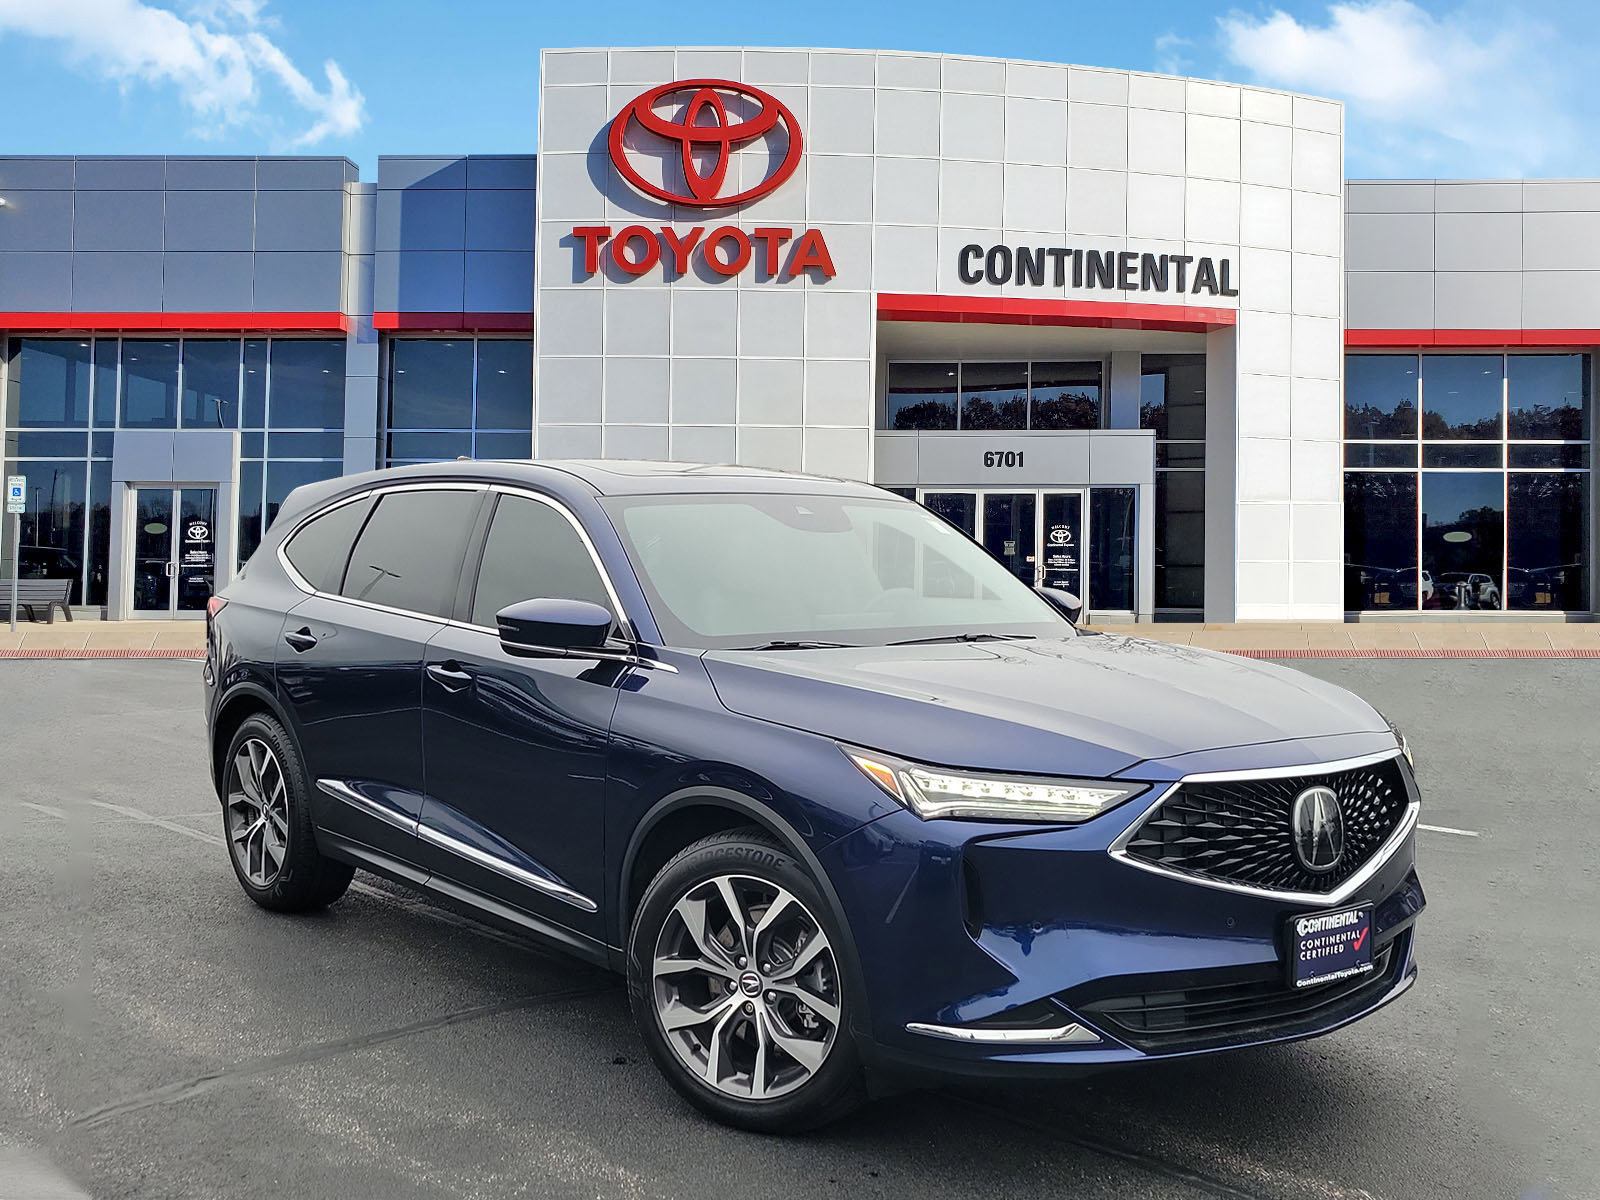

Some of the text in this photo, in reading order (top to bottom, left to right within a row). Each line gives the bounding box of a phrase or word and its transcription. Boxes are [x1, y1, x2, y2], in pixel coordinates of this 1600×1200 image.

[572, 225, 837, 277] TOYOTA
[958, 244, 1239, 297] CONTINENTAL
[983, 450, 1024, 468] 6701
[1297, 910, 1358, 936] CONTINENTAL
[1300, 930, 1360, 950] CONTINENTAL
[1300, 944, 1344, 960] CERTIFIED
[1296, 964, 1373, 987] ContinentalToyota.com
